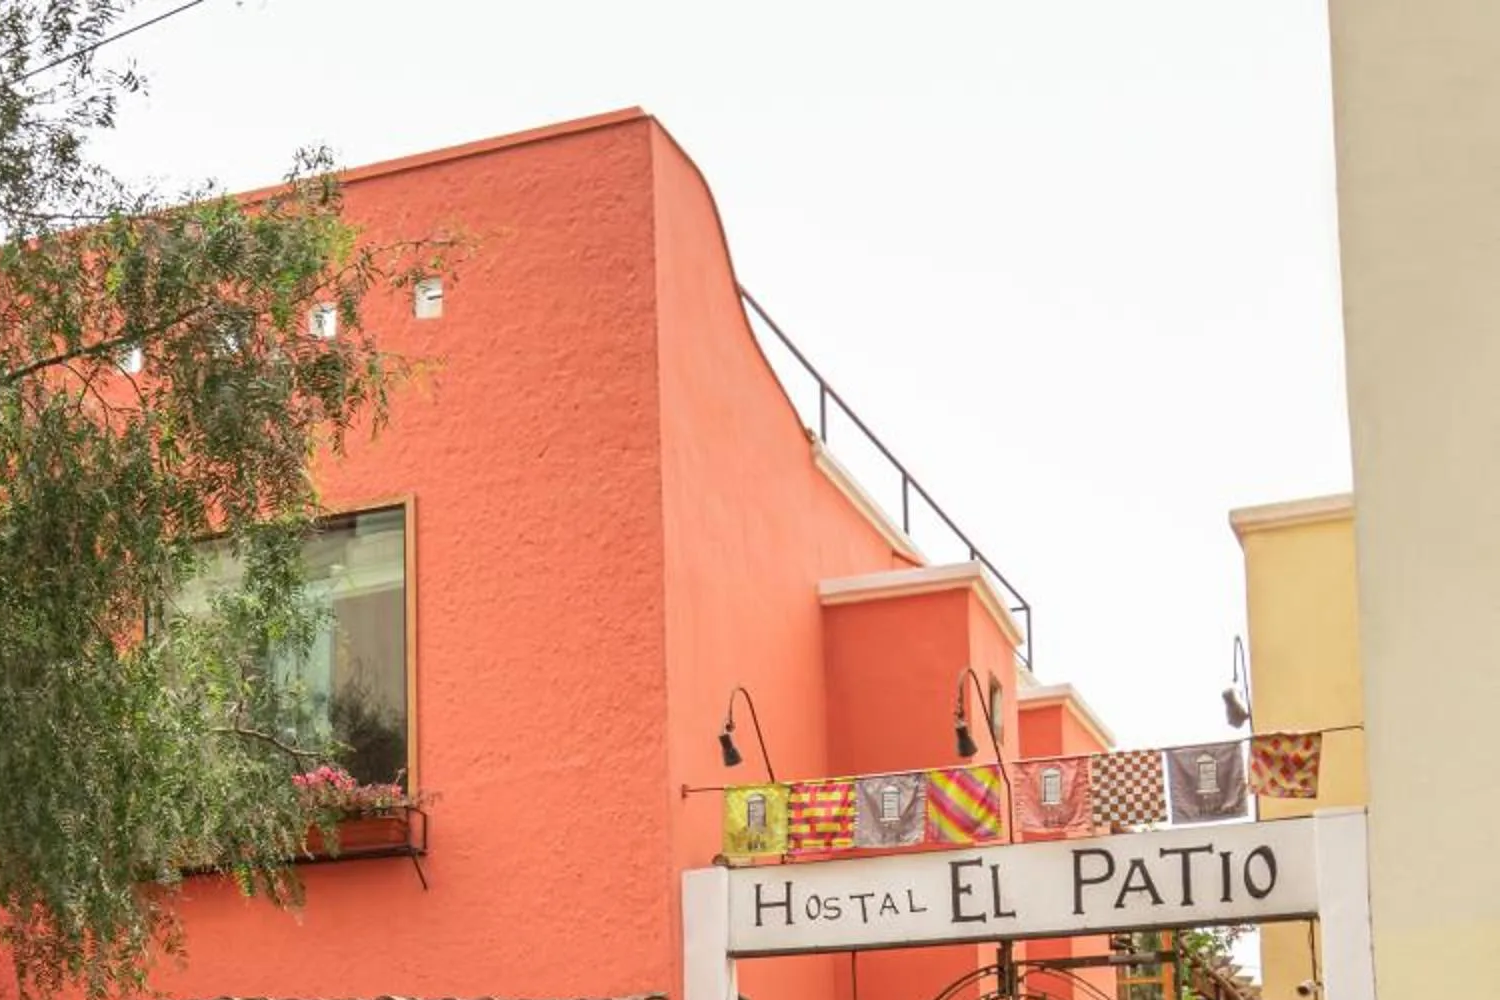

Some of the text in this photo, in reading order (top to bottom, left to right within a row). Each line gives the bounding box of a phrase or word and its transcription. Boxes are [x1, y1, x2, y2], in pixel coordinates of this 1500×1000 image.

[754, 844, 1277, 926] HOSTAL EL PATIO
